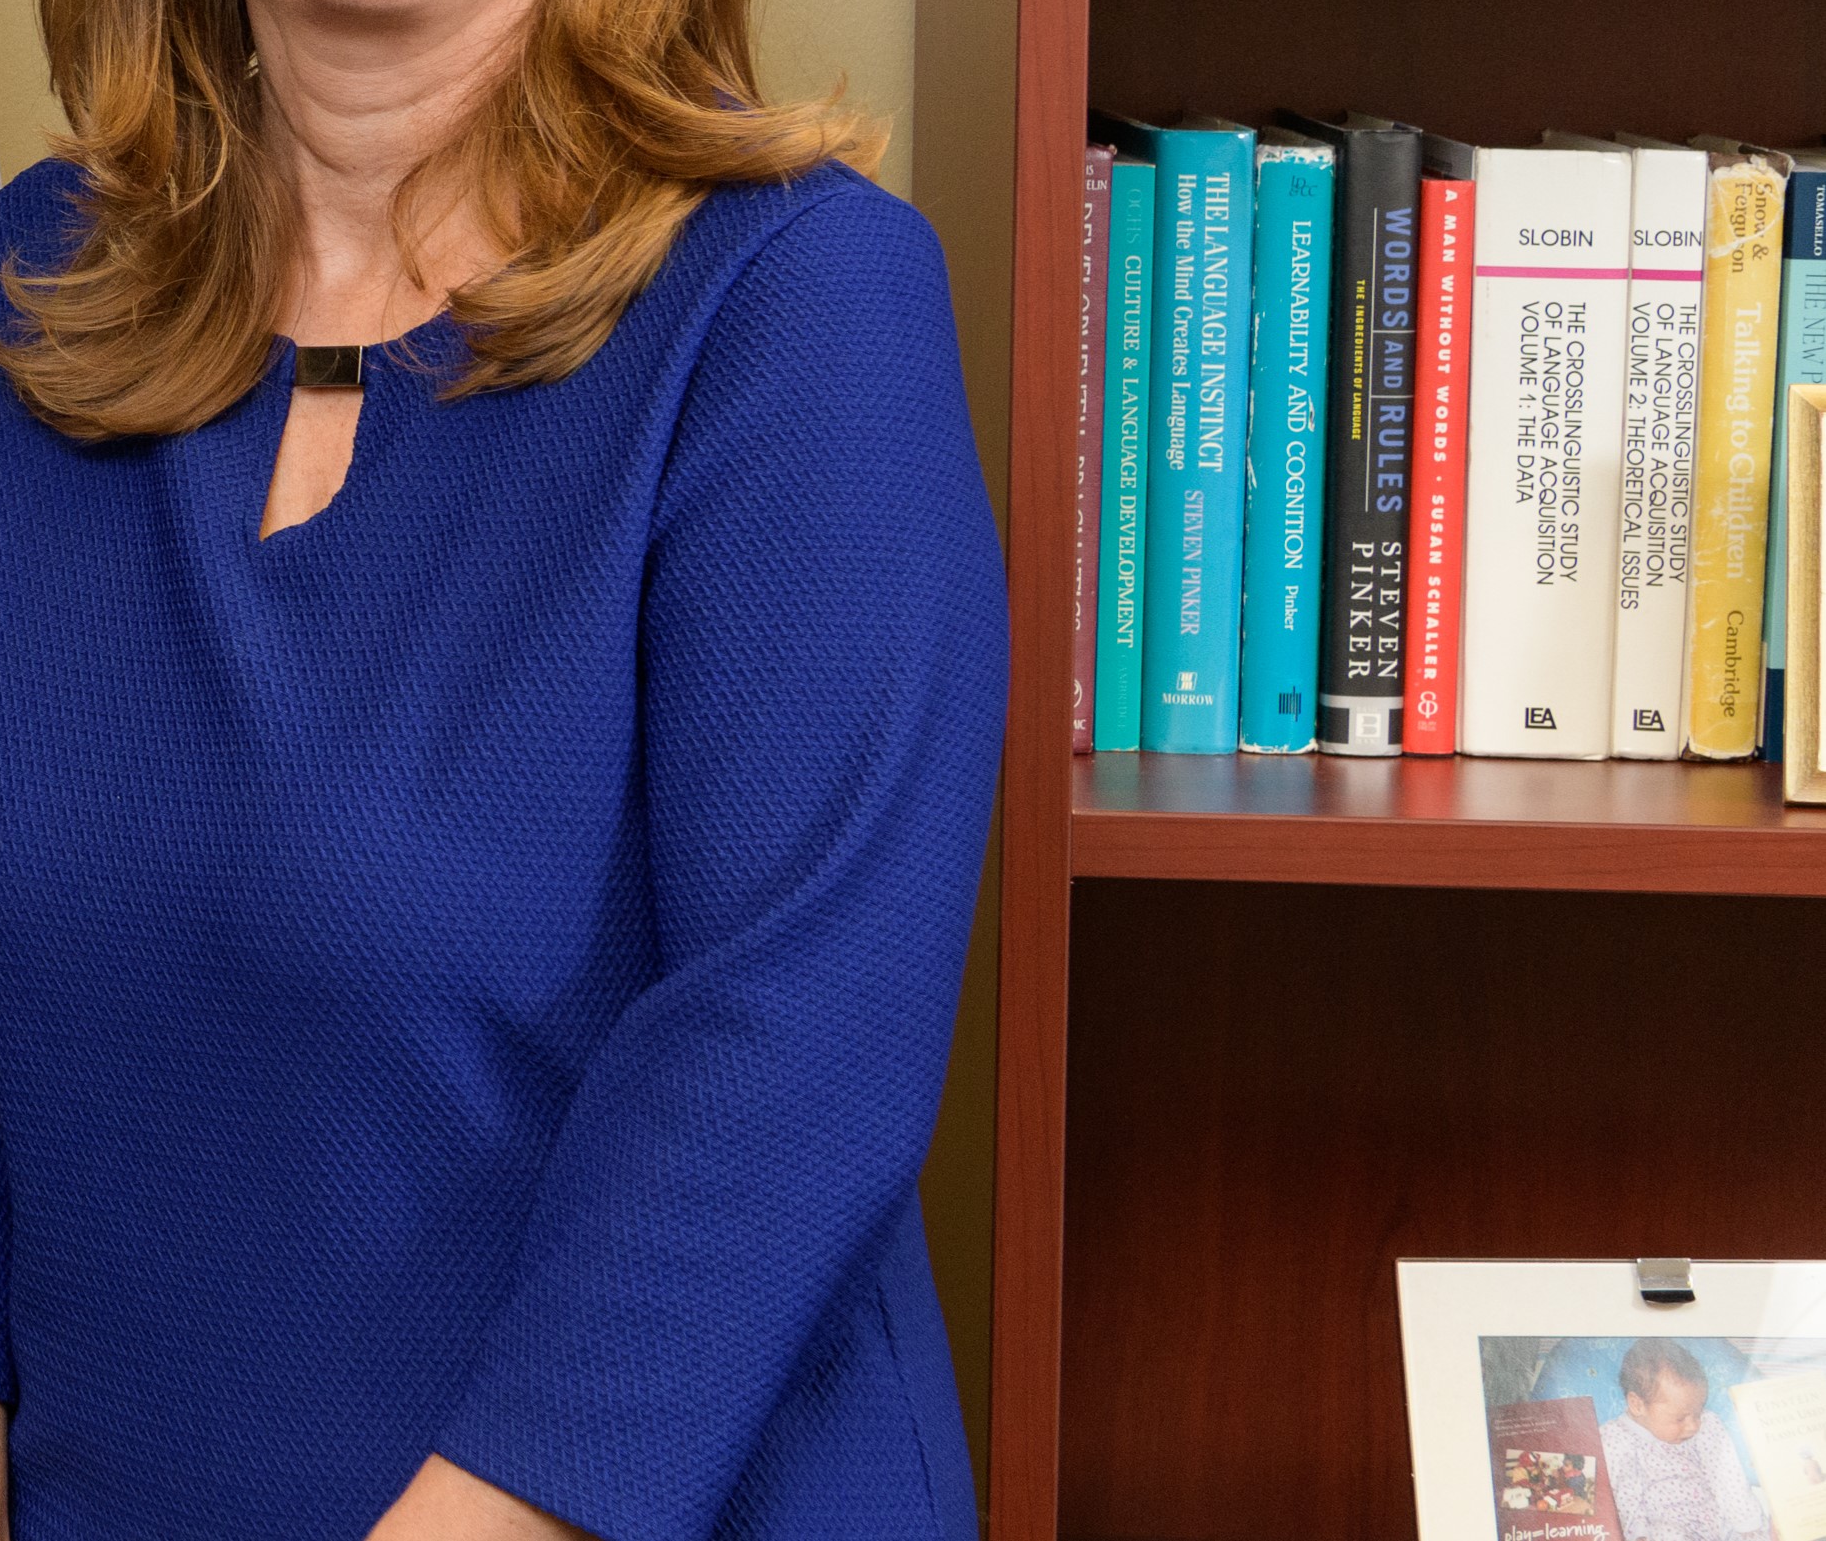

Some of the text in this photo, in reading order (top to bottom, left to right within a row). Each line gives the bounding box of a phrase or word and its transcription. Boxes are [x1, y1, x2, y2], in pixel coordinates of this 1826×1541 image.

[1518, 228, 1594, 247] SLOBIN
[1633, 229, 1703, 247] SLOBIN
[1752, 182, 1773, 261] Snow &
[1814, 184, 1826, 257] TOMASELLO
[1166, 174, 1197, 470] How the Mind Creates Language
[1198, 172, 1230, 472] THE LANGUAGE INSTINCT
[1284, 221, 1311, 569] LEARNABILITY AND COGNITION
[1351, 279, 1366, 440] THE INGREDIENTS OF LANGUAGE
[1376, 208, 1412, 513] WORDS AND RULES
[1802, 274, 1826, 366] THE NEW
[1117, 255, 1141, 648] CULTURE & LANGUAGE DEVELOPMENT
[1424, 189, 1458, 679] A MAN WITHOUT WORDS SUSAN SCHALLER
[1516, 301, 1539, 503] VOLUME 1: THE DATA
[1537, 302, 1563, 585] OF LANGUAGE ACQUISITION
[1560, 302, 1586, 582] THE CROSSLINGUISTIC STUDY
[1620, 302, 1651, 609] VOLUME 2: THEORETICAL ISSUES
[1646, 303, 1675, 587] OF LANGUAGE ACQUISITION
[1667, 304, 1697, 583] THE CROSSLINGUISTIC STUDY
[1725, 301, 1762, 580] Talking to Children
[1181, 490, 1204, 634] STEVEN PINKER
[1284, 585, 1299, 631] Pinker
[1348, 541, 1374, 679] PINKER
[1377, 541, 1402, 679] STEVEN
[1162, 693, 1214, 706] MORROW
[1524, 707, 1557, 730] LEA
[1633, 708, 1666, 732] LEA
[1719, 609, 1746, 718] Cambridge
